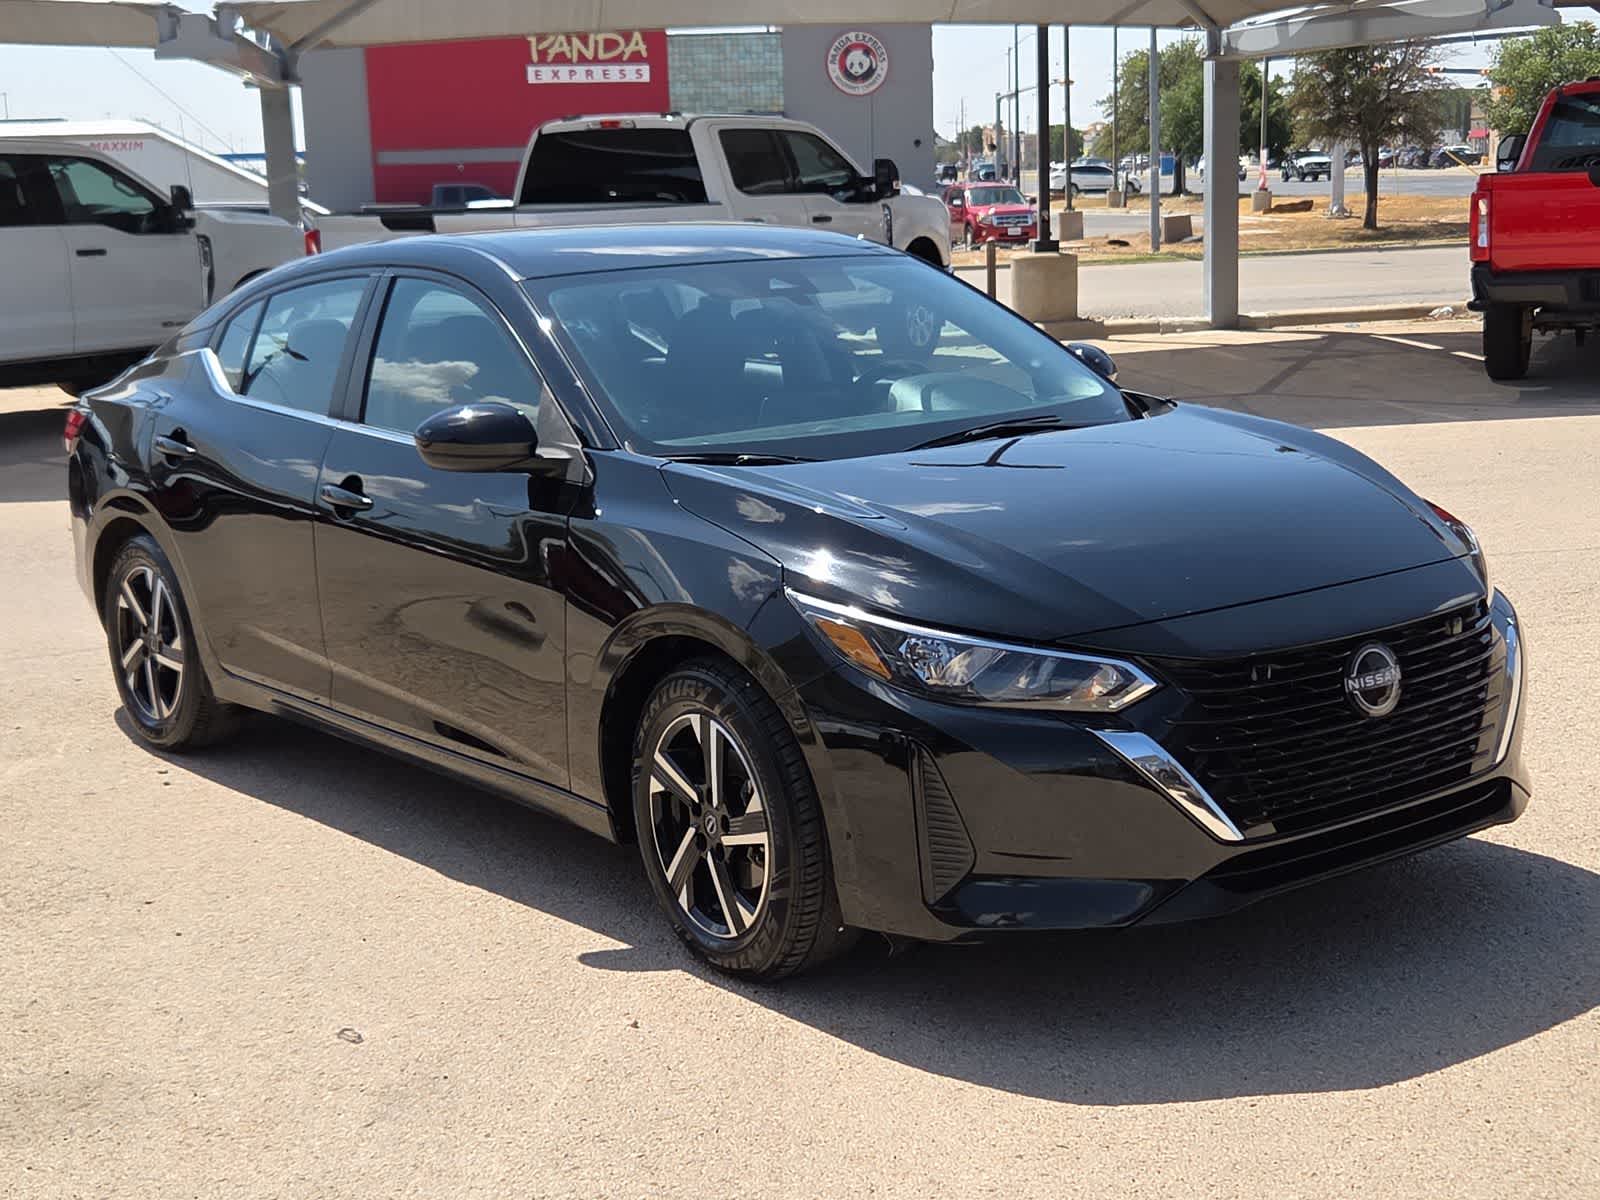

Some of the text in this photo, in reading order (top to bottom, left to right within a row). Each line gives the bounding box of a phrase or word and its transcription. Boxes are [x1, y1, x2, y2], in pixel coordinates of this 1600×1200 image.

[527, 32, 648, 63] PANDA
[829, 33, 887, 65] PANDA EXPRESS
[533, 68, 644, 81] EXPRESS
